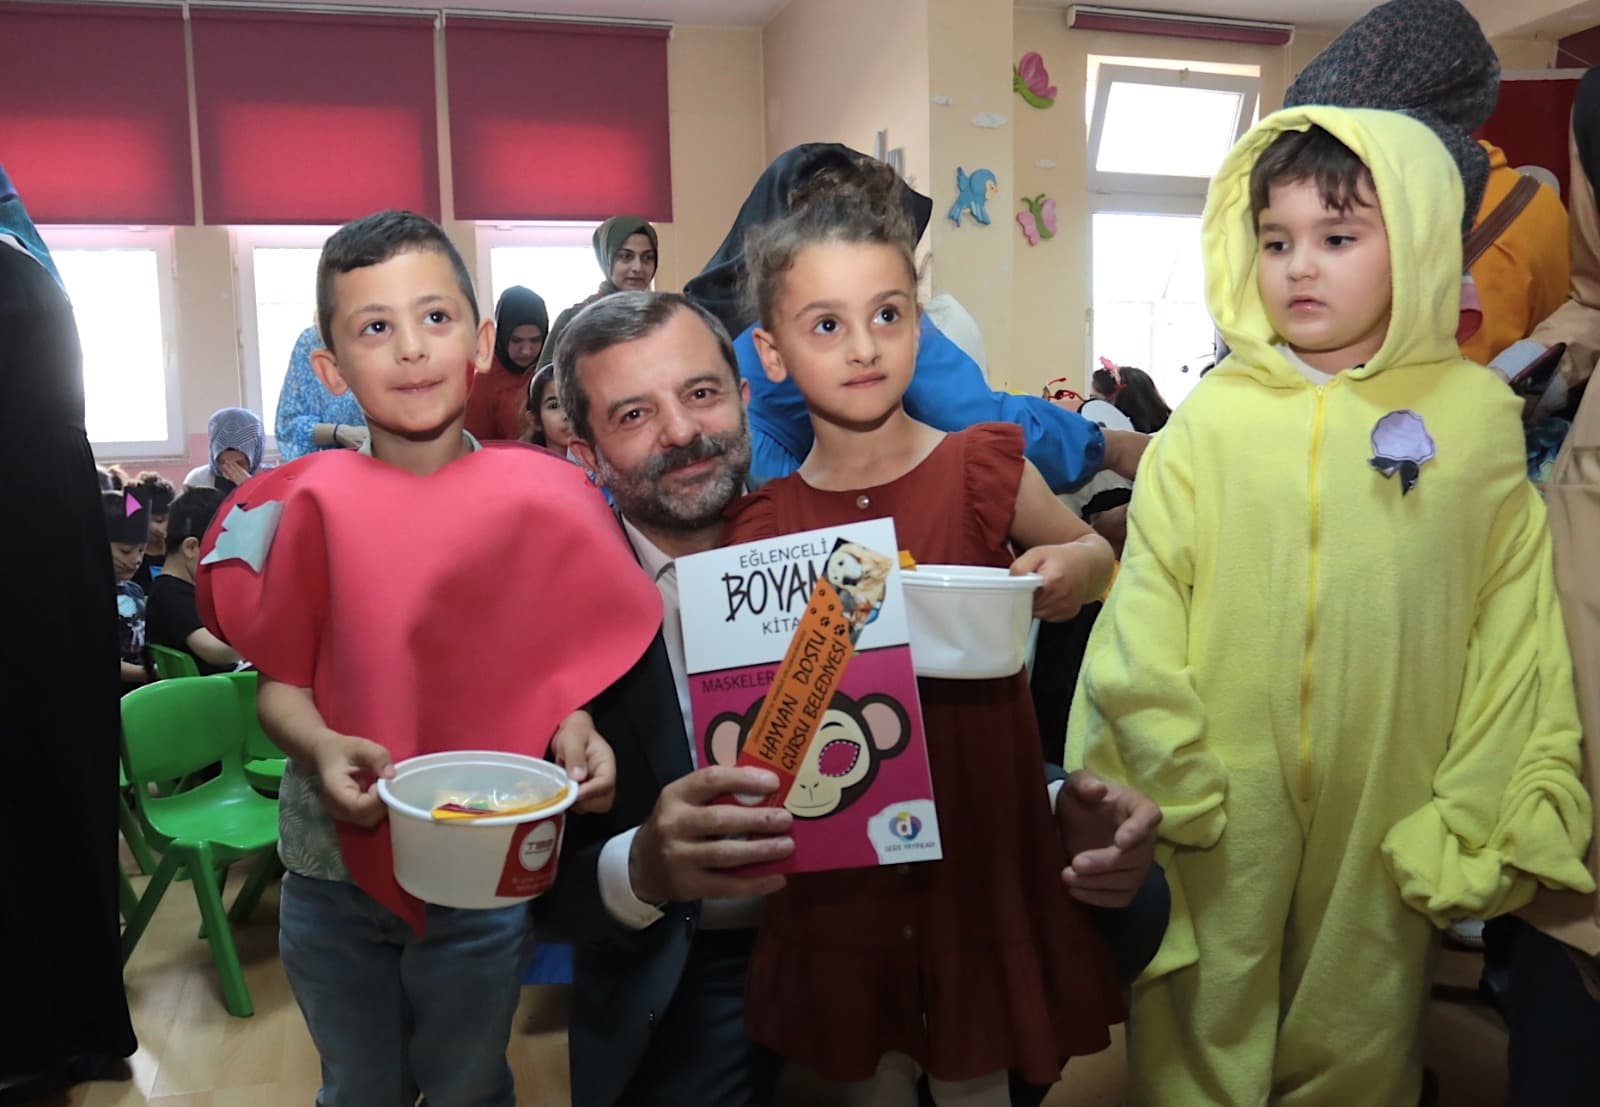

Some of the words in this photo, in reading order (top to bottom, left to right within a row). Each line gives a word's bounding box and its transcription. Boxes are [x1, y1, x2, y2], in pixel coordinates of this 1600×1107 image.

[739, 538, 829, 569] EĞLENCELİ
[721, 559, 829, 623] BOYAM
[762, 615, 801, 635] KİTA
[701, 672, 775, 694] MASKELER
[759, 693, 799, 761] HAYVAN
[792, 630, 827, 685] DOSTU
